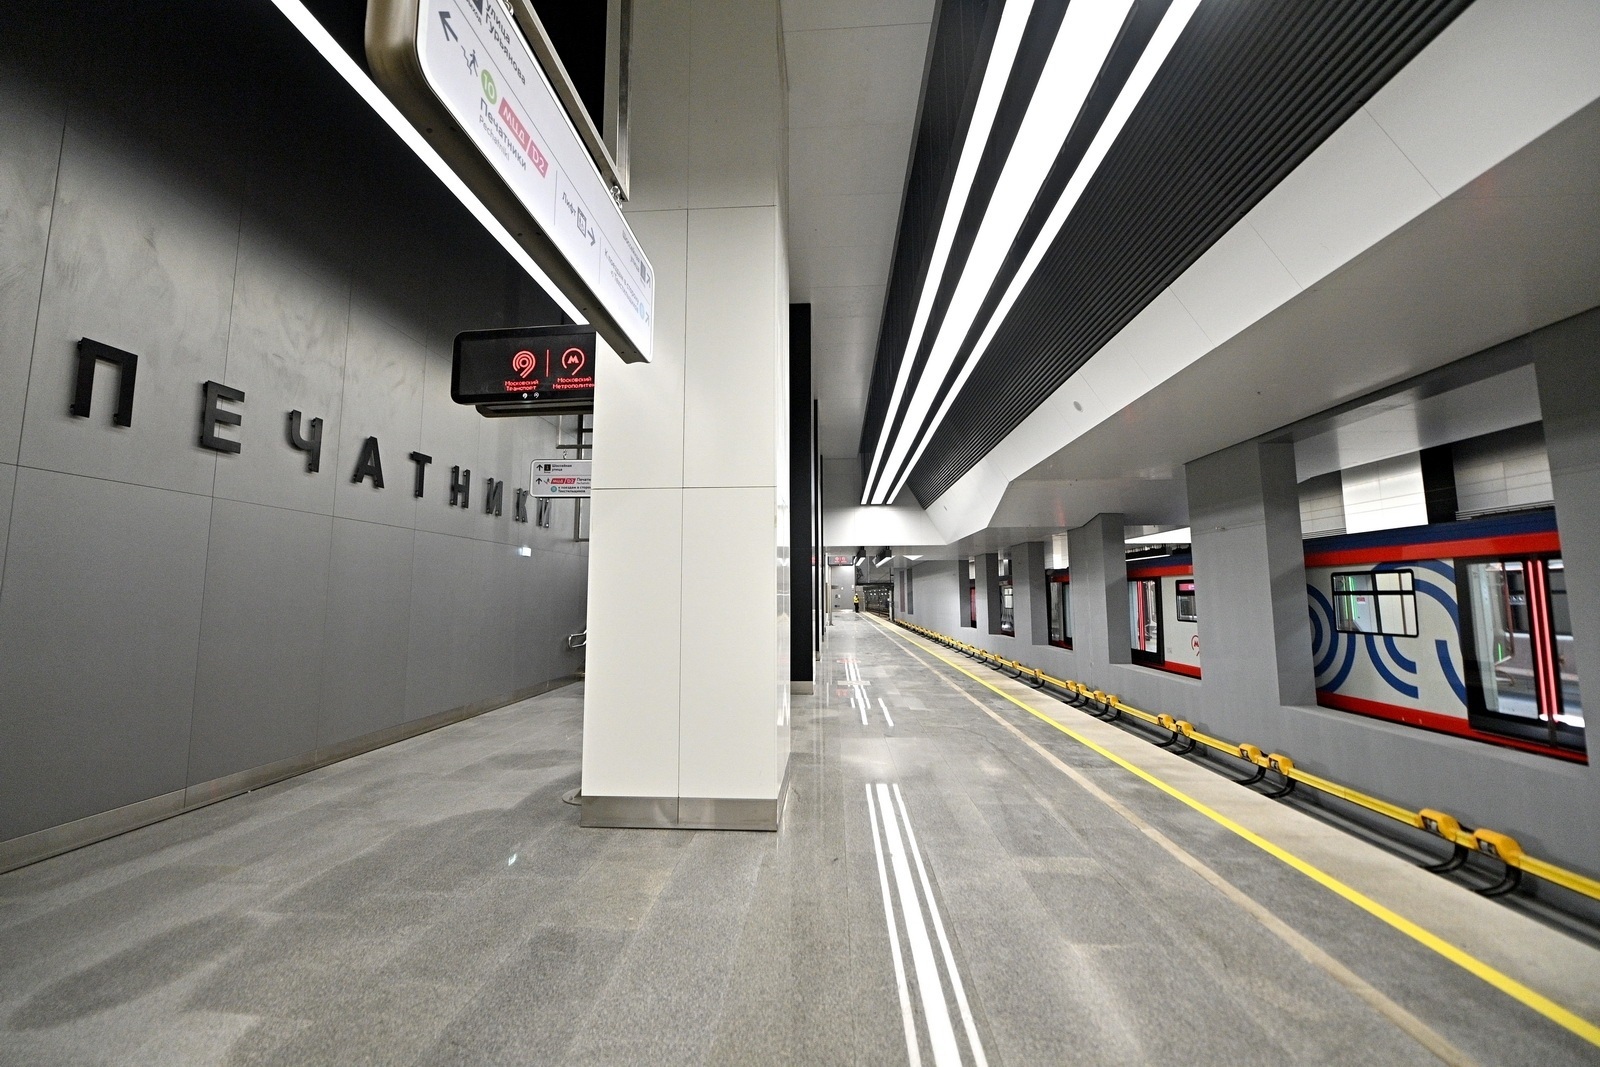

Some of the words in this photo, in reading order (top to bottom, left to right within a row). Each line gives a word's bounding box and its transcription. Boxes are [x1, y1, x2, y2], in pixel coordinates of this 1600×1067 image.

[486, 12, 526, 85] Гурьянова
[483, 72, 496, 100] 10
[478, 114, 510, 162] Pechatniki
[480, 97, 526, 171] Печатники
[501, 103, 527, 147] МЦД
[531, 144, 545, 173] D2
[562, 192, 577, 217] Лифт
[505, 379, 539, 387] Московский
[73, 337, 552, 528] ПЕЧАТНИКИ
